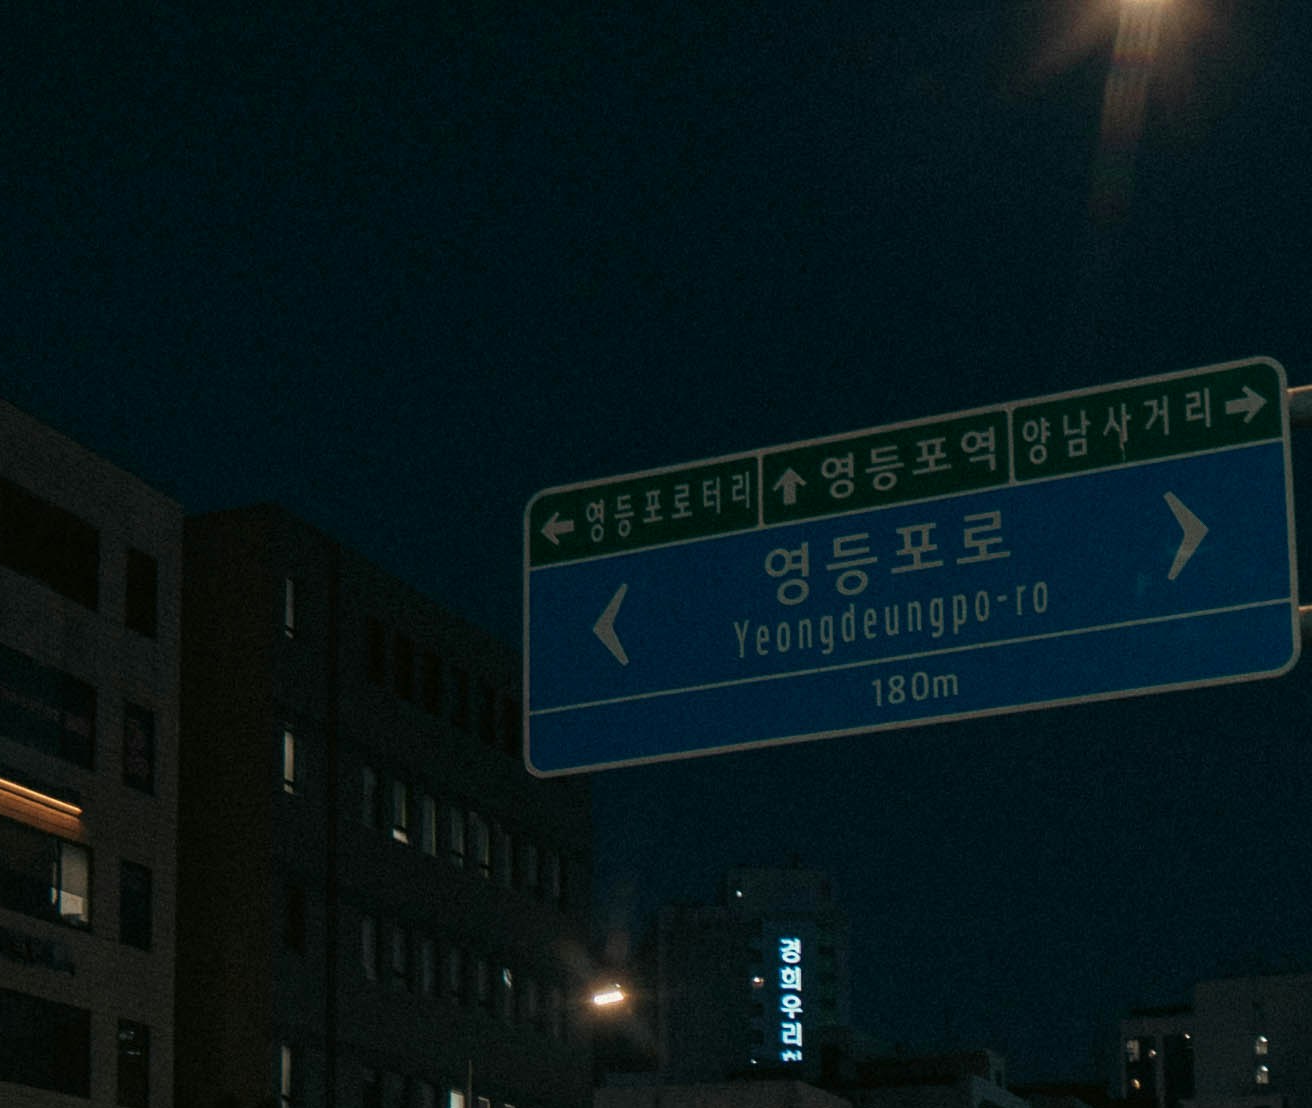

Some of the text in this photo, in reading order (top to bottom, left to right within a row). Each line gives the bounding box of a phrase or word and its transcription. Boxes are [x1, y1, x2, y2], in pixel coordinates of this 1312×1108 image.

[819, 427, 1000, 501] 영등포역
[1021, 387, 1215, 465] 양남사거리
[586, 469, 752, 544] 영등포로터리
[764, 511, 1012, 606] 영등포로
[732, 580, 1050, 662] Yeongdeungpo-ro
[870, 668, 961, 708] 180m
